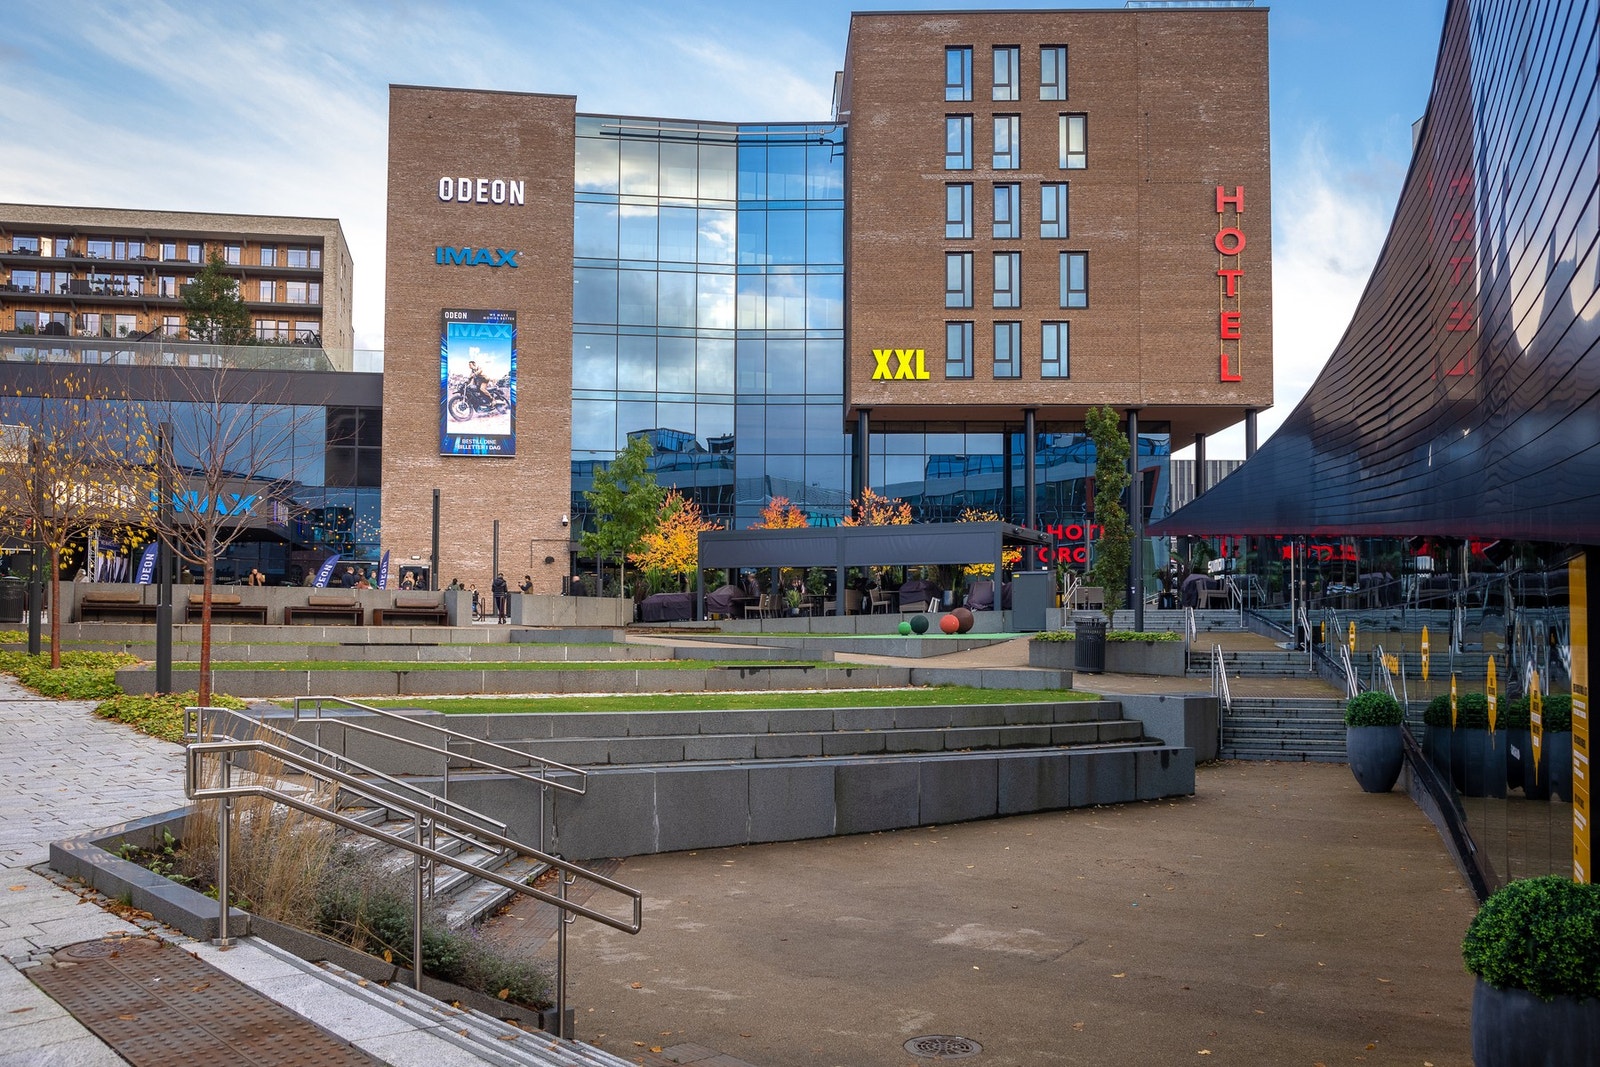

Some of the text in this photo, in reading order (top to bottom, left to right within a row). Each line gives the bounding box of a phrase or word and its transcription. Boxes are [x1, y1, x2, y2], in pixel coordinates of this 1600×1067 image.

[439, 177, 524, 205] ODEON
[436, 246, 518, 268] IMAX
[1214, 185, 1246, 381] HOTEL
[444, 311, 468, 319] ODEON
[449, 324, 511, 338] IMAX
[872, 349, 930, 380] XXL
